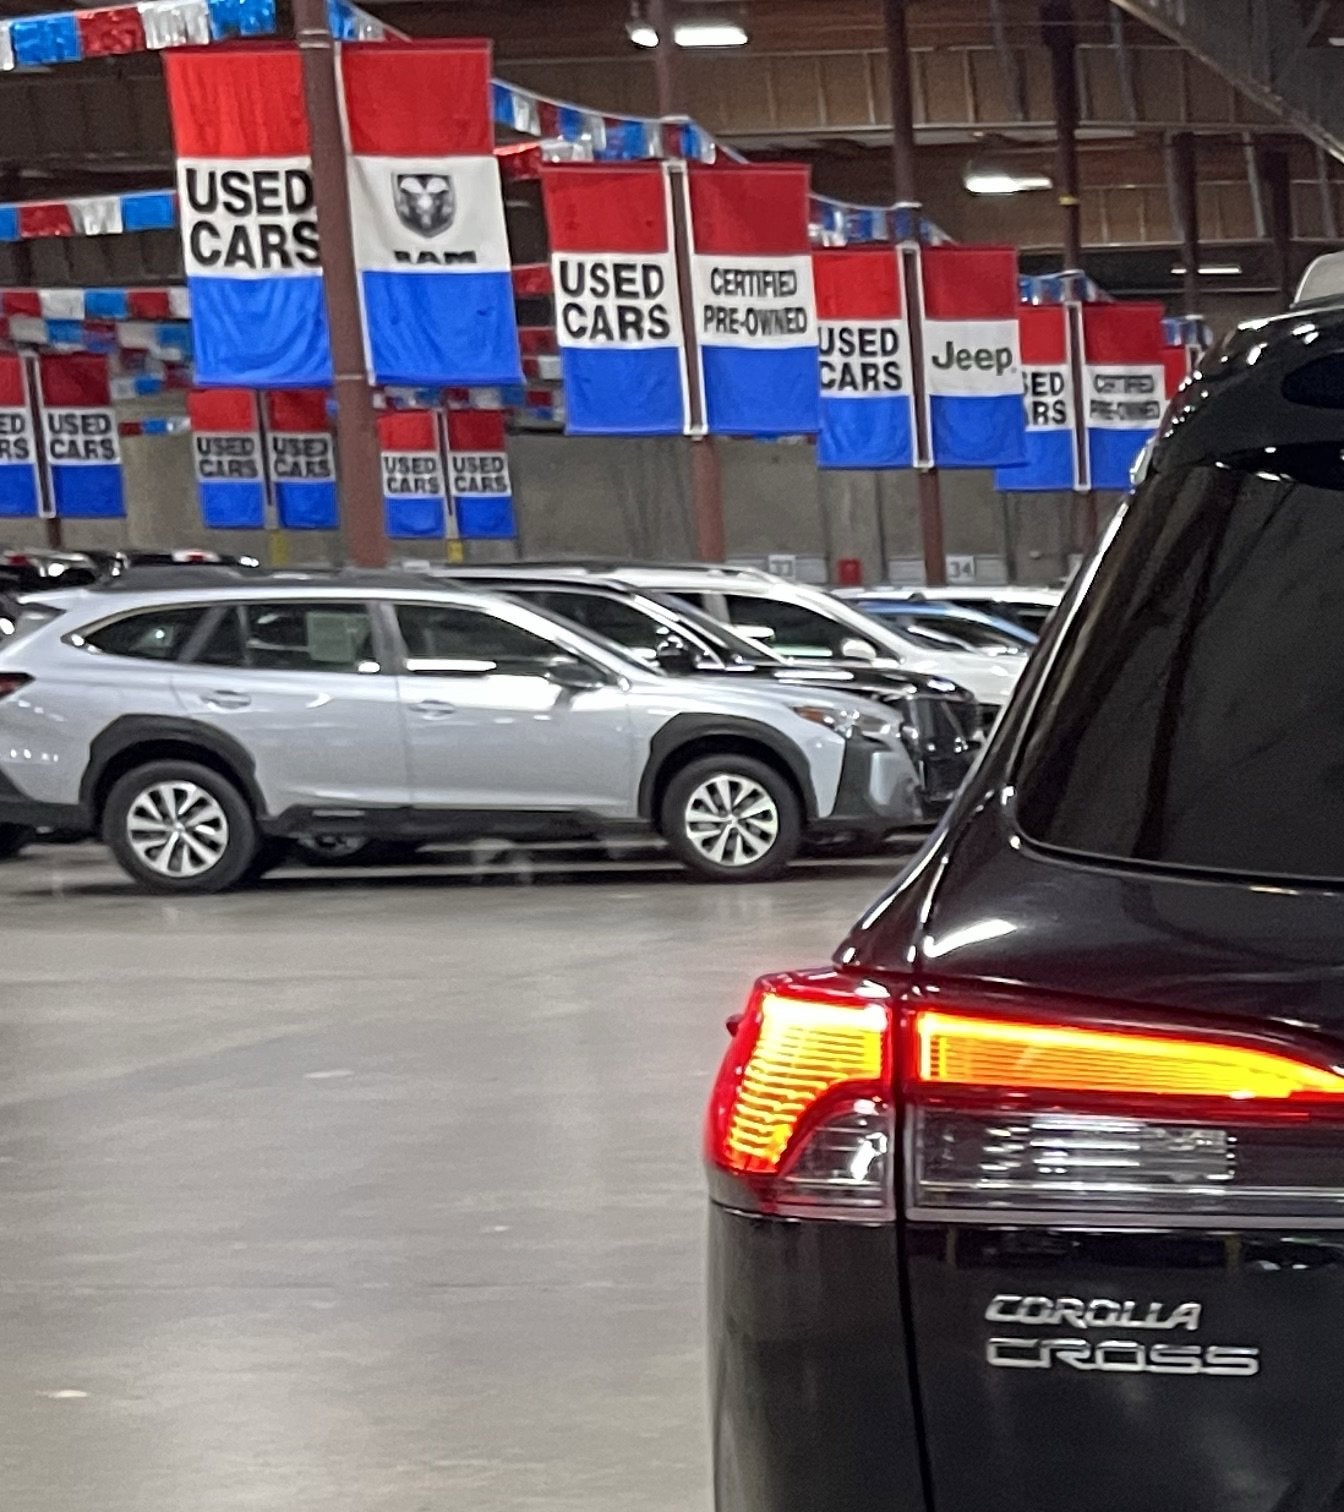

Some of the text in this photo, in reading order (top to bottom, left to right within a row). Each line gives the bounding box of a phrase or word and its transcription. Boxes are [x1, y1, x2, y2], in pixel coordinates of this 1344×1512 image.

[185, 168, 317, 216] USED
[190, 221, 322, 268] CARS
[559, 260, 665, 300] USED
[562, 302, 672, 342] CARS
[704, 304, 808, 336] PRE-OWNED
[818, 326, 900, 357] USED
[932, 340, 1014, 376] Jeep
[819, 361, 903, 391] CARS
[48, 413, 112, 435] USED
[50, 438, 115, 460] CARS
[197, 437, 255, 456] USED
[273, 437, 329, 457] USED
[200, 459, 258, 477] CARS
[274, 457, 331, 478] CARS
[384, 456, 437, 474] USED
[453, 456, 504, 474] USED
[387, 476, 440, 494] CARS
[455, 476, 508, 493] CARS
[985, 1294, 1201, 1331] COROLLA
[986, 1337, 1260, 1376] CROSS
